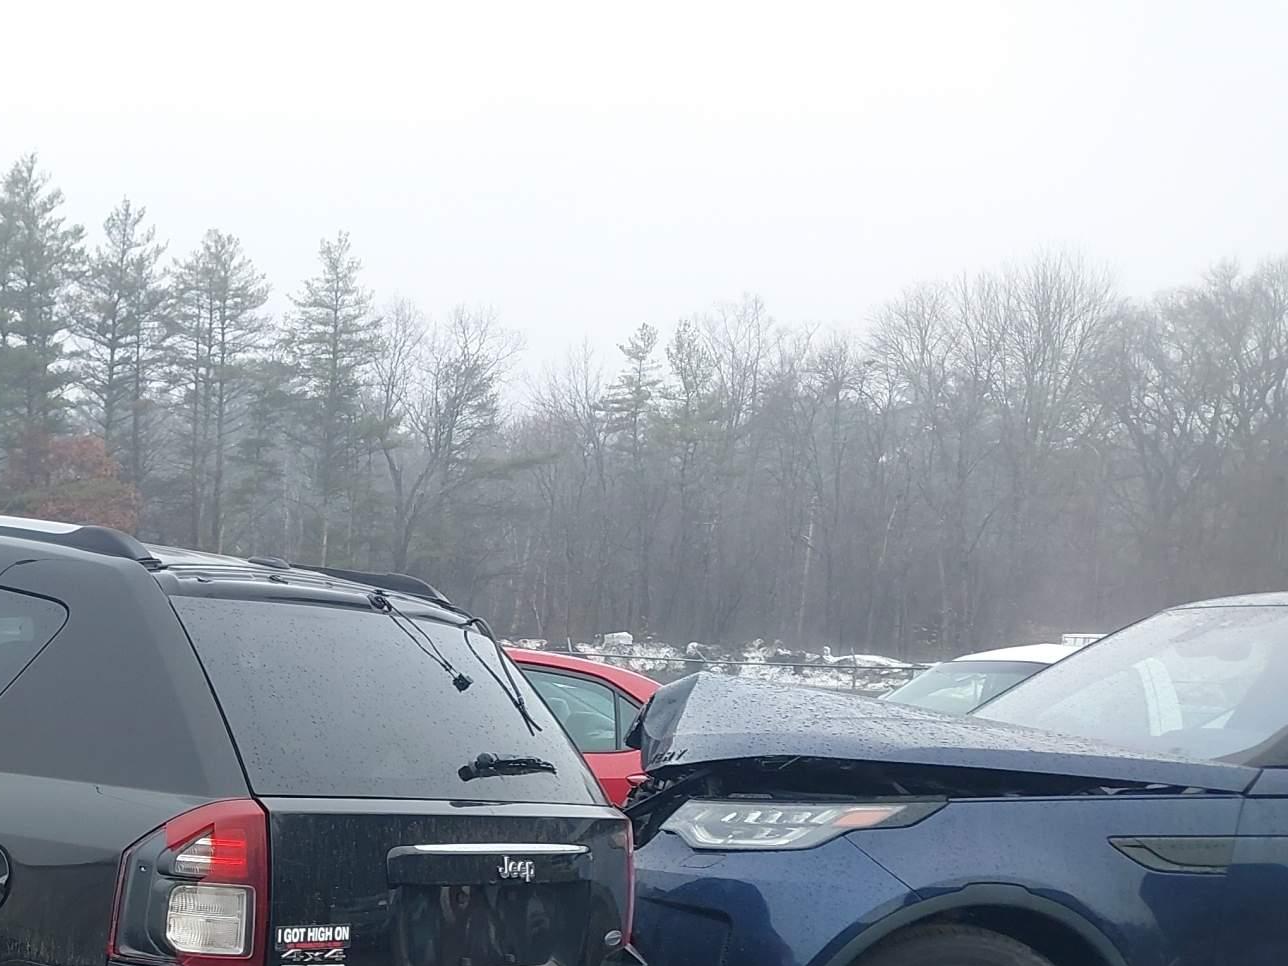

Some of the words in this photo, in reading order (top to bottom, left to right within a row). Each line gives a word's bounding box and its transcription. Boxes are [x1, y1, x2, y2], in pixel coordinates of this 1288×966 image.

[497, 855, 536, 882] Jeep
[277, 928, 282, 943] I
[284, 928, 306, 943] GOT
[307, 927, 333, 942] HIGH
[334, 926, 350, 941] ON
